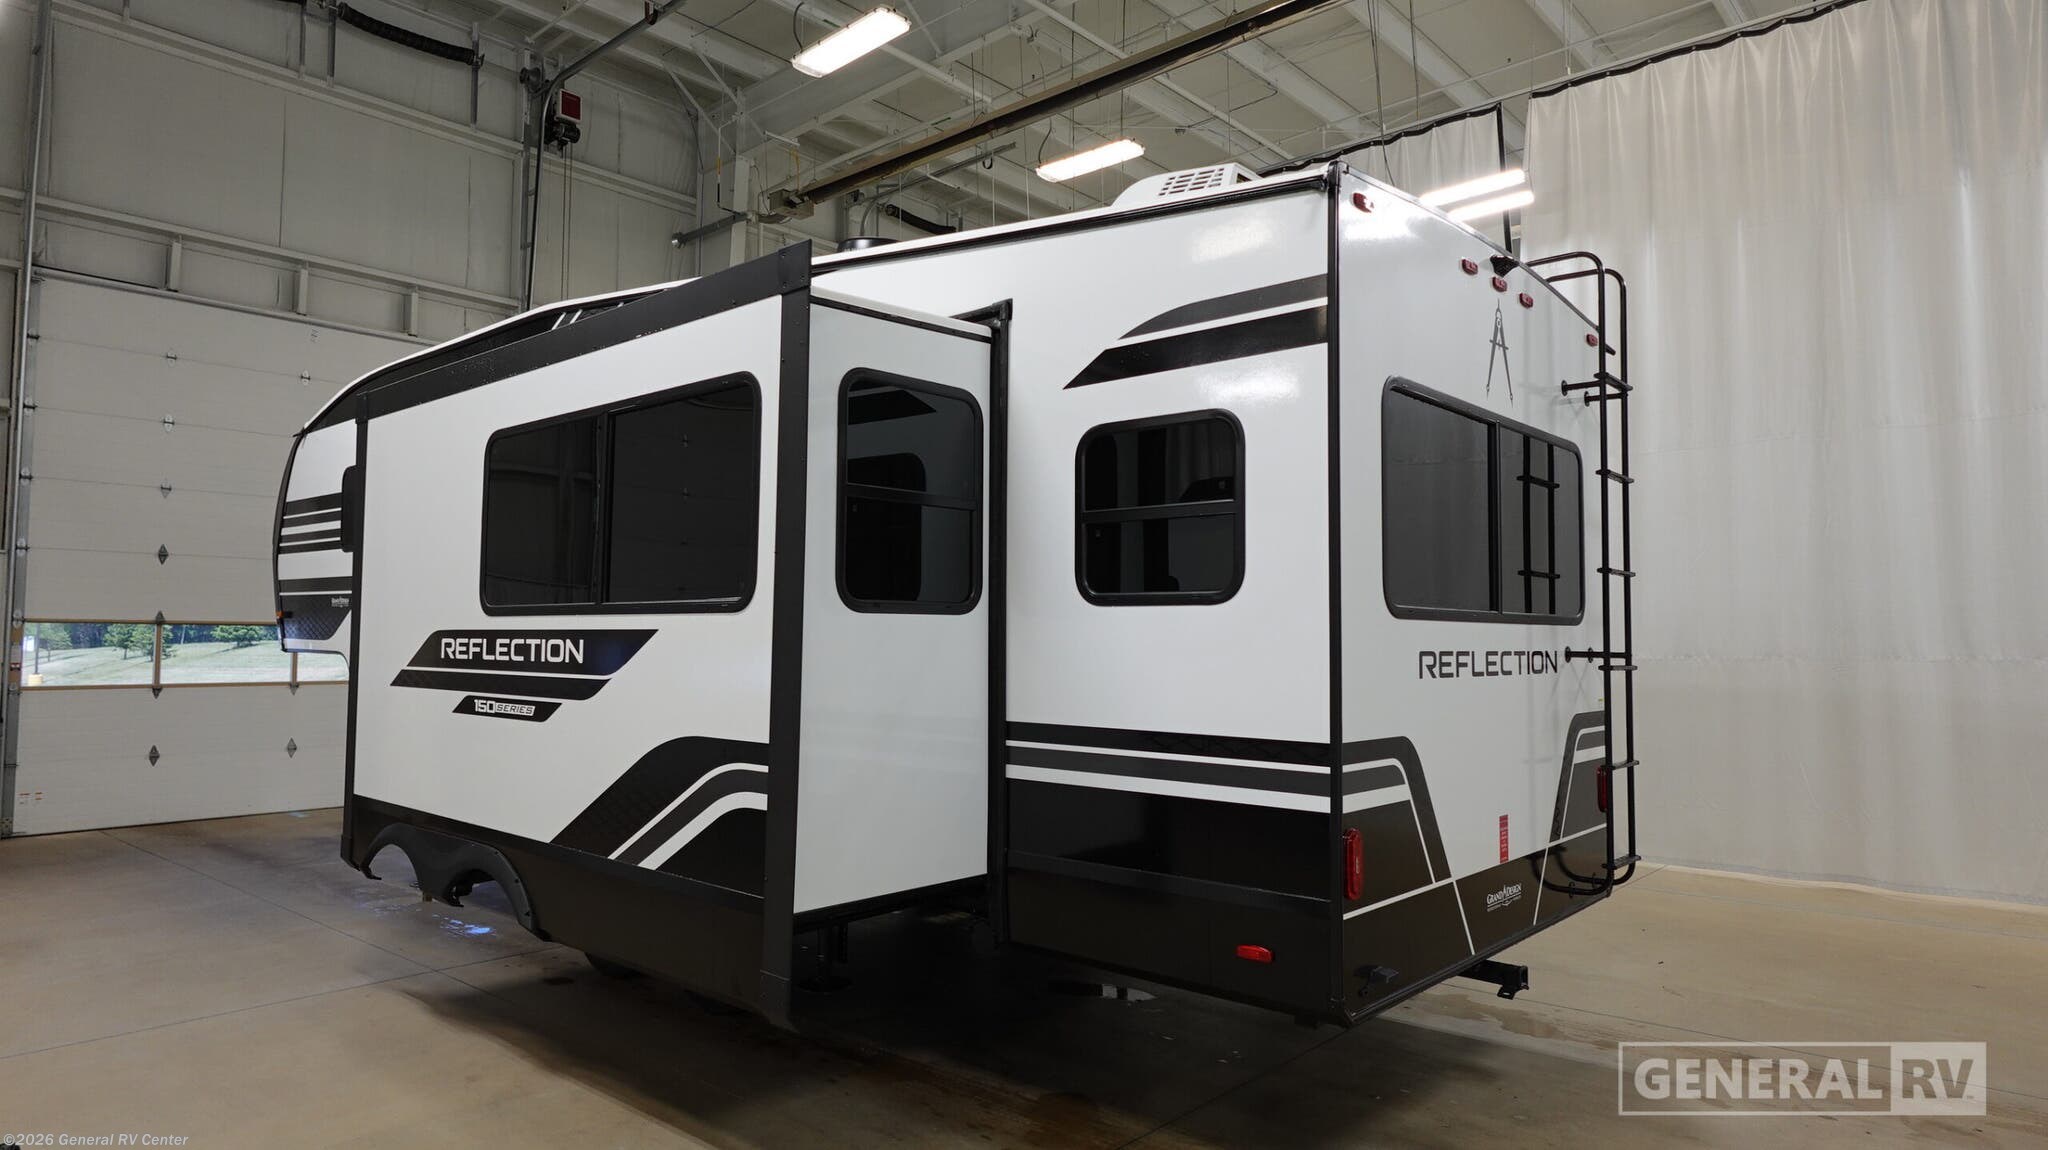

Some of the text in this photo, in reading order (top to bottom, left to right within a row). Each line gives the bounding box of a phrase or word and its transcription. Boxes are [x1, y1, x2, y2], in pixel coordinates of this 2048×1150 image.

[441, 638, 584, 664] REFLECTION
[1418, 650, 1558, 680] REFLECTION
[474, 699, 534, 716] 150 SERIES
